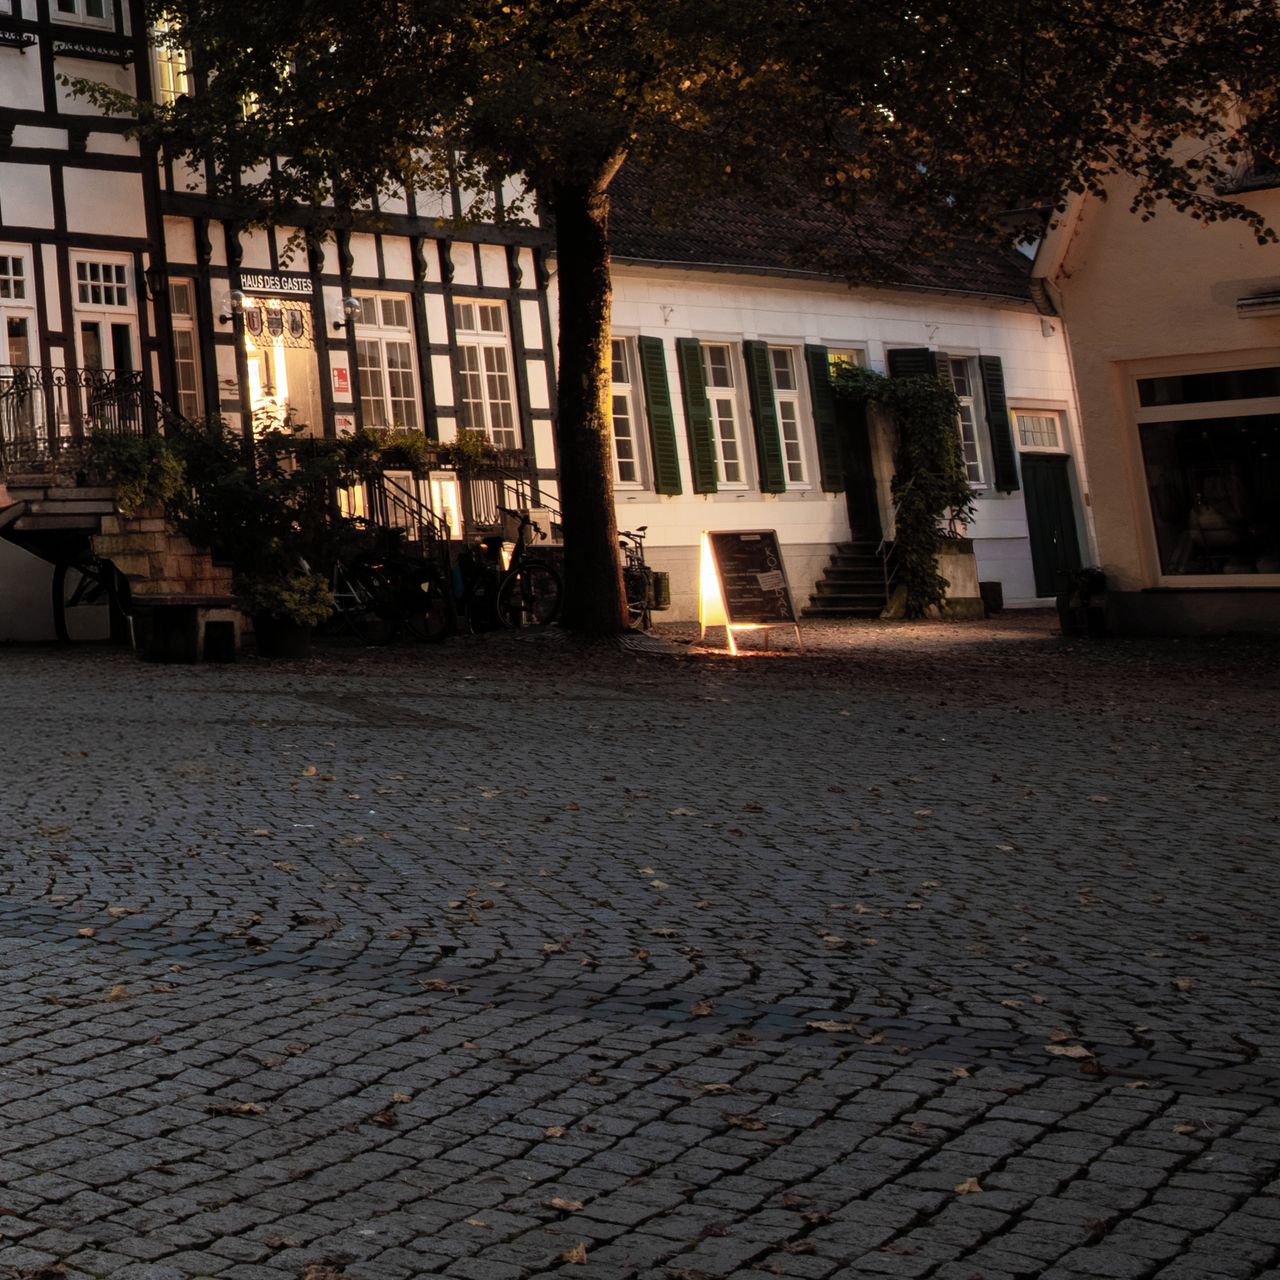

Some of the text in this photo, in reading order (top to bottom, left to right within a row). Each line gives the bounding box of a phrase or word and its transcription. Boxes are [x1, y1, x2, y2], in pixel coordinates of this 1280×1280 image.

[240, 274, 313, 291] HAUS DES GASTES
